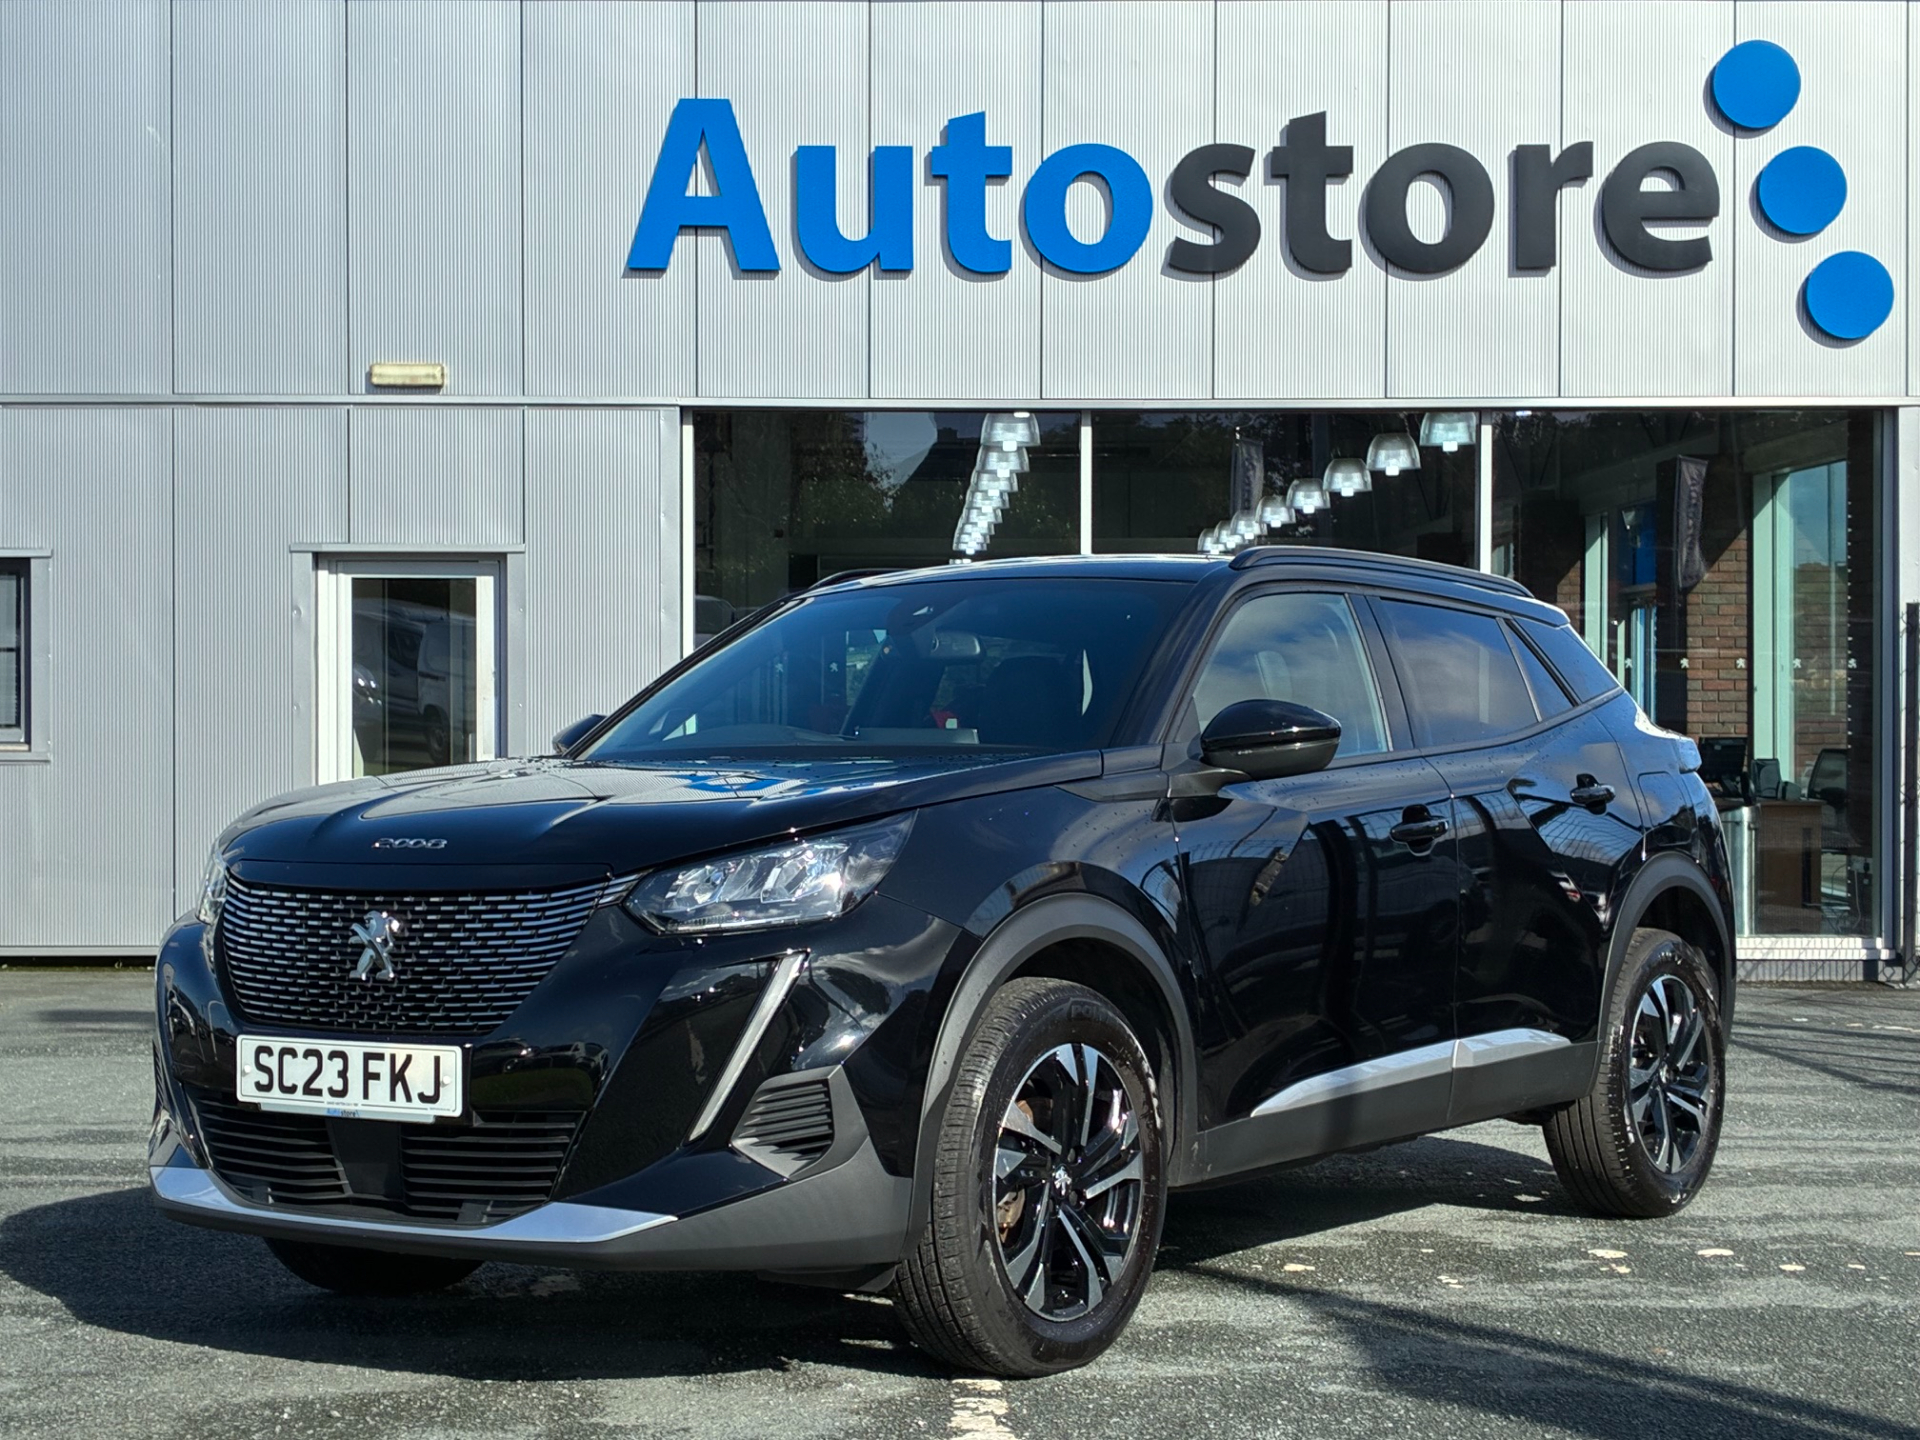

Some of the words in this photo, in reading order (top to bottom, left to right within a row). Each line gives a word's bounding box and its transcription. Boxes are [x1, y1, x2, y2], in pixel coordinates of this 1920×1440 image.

[627, 98, 1720, 273] Autostore
[372, 837, 448, 849] 2008
[253, 1045, 350, 1099] SC23
[362, 1051, 442, 1105] FKJ
